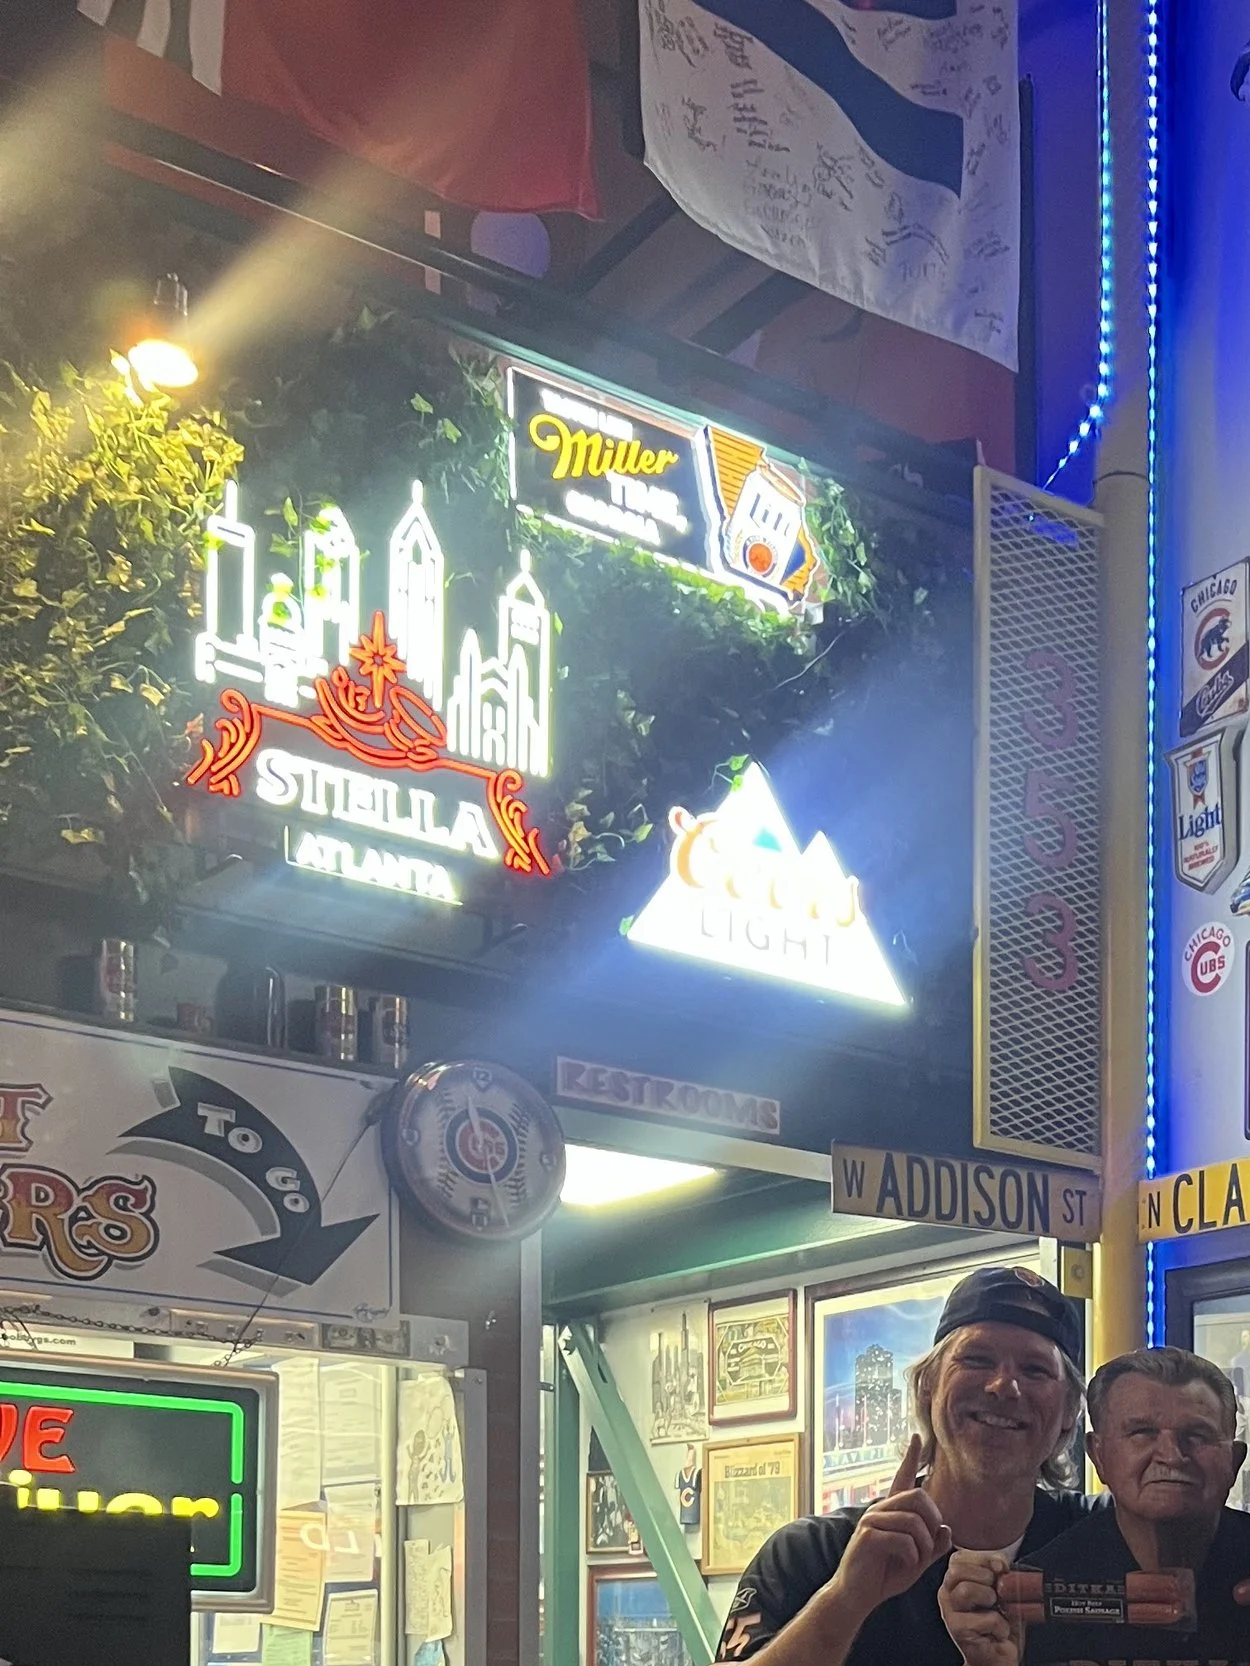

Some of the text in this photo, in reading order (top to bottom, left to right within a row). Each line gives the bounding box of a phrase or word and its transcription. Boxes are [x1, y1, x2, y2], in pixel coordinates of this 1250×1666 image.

[529, 413, 678, 479] Miller
[1190, 579, 1238, 613] CHICAGO
[256, 748, 501, 860] STELLA
[1179, 804, 1221, 840] Light
[701, 906, 832, 966] LIGHT
[1184, 926, 1231, 962] CHICAGO
[1191, 941, 1226, 993] CUBS
[559, 1061, 780, 1130] RESTROOMS
[197, 1103, 263, 1154] TO
[265, 1166, 310, 1214] GO
[842, 1152, 1088, 1234] W ADDISON ST
[1147, 1190, 1162, 1229] N
[1054, 1583, 1118, 1595] DITKA
